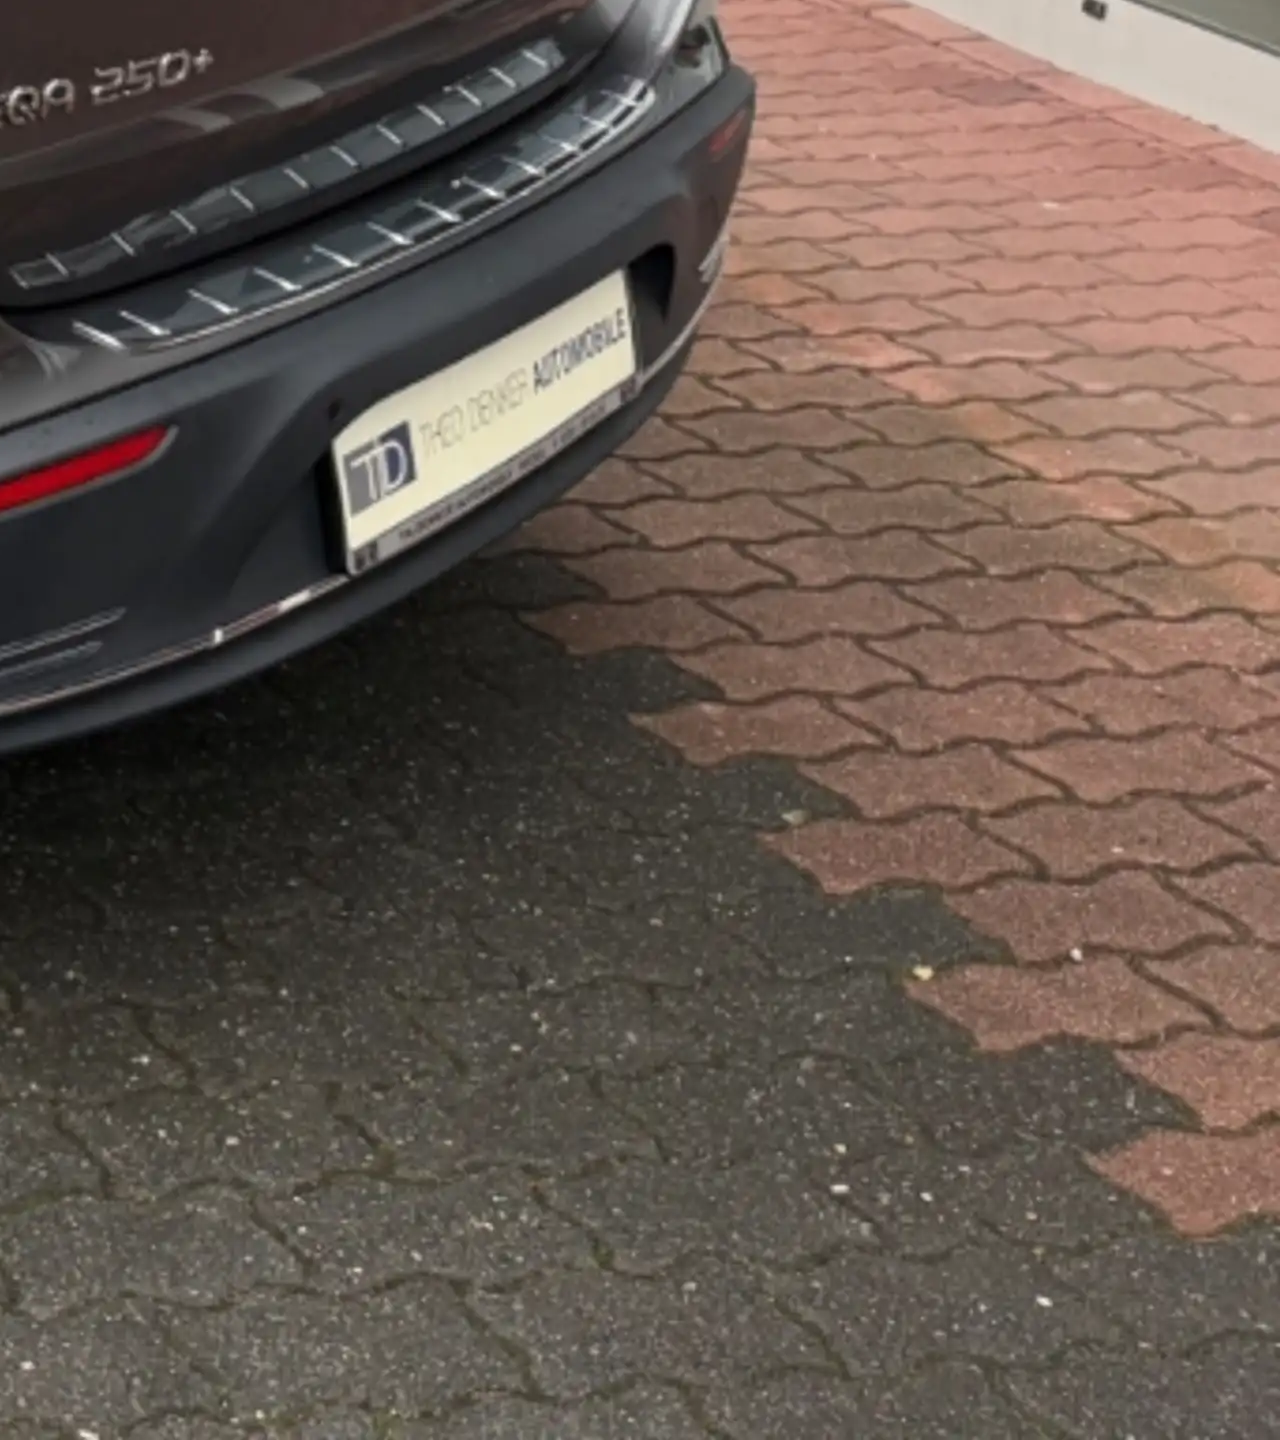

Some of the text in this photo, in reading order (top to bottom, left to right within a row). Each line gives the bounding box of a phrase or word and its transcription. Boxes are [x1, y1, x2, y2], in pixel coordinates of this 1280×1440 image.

[90, 47, 214, 106] 250+
[420, 406, 464, 459] THEO
[533, 307, 626, 395] AUTOMOBILE
